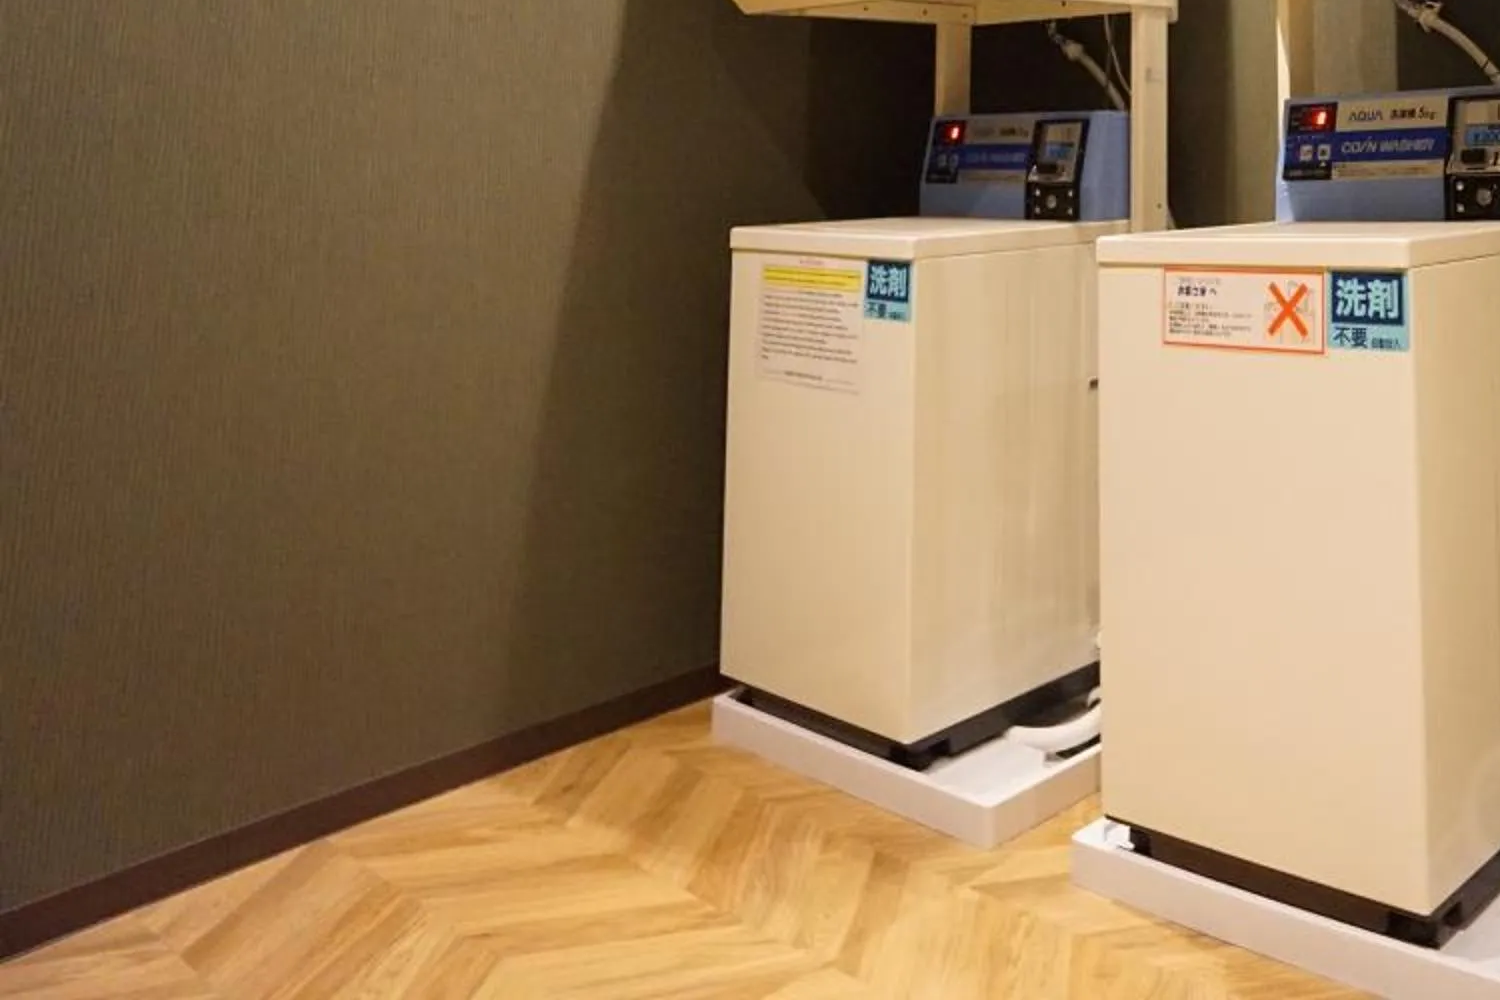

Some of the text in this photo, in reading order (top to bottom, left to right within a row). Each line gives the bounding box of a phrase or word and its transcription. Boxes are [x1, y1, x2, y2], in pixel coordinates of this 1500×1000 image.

[869, 264, 907, 297] 洗剤
[1335, 277, 1399, 319] 洗剤
[1333, 327, 1368, 350] 不要
